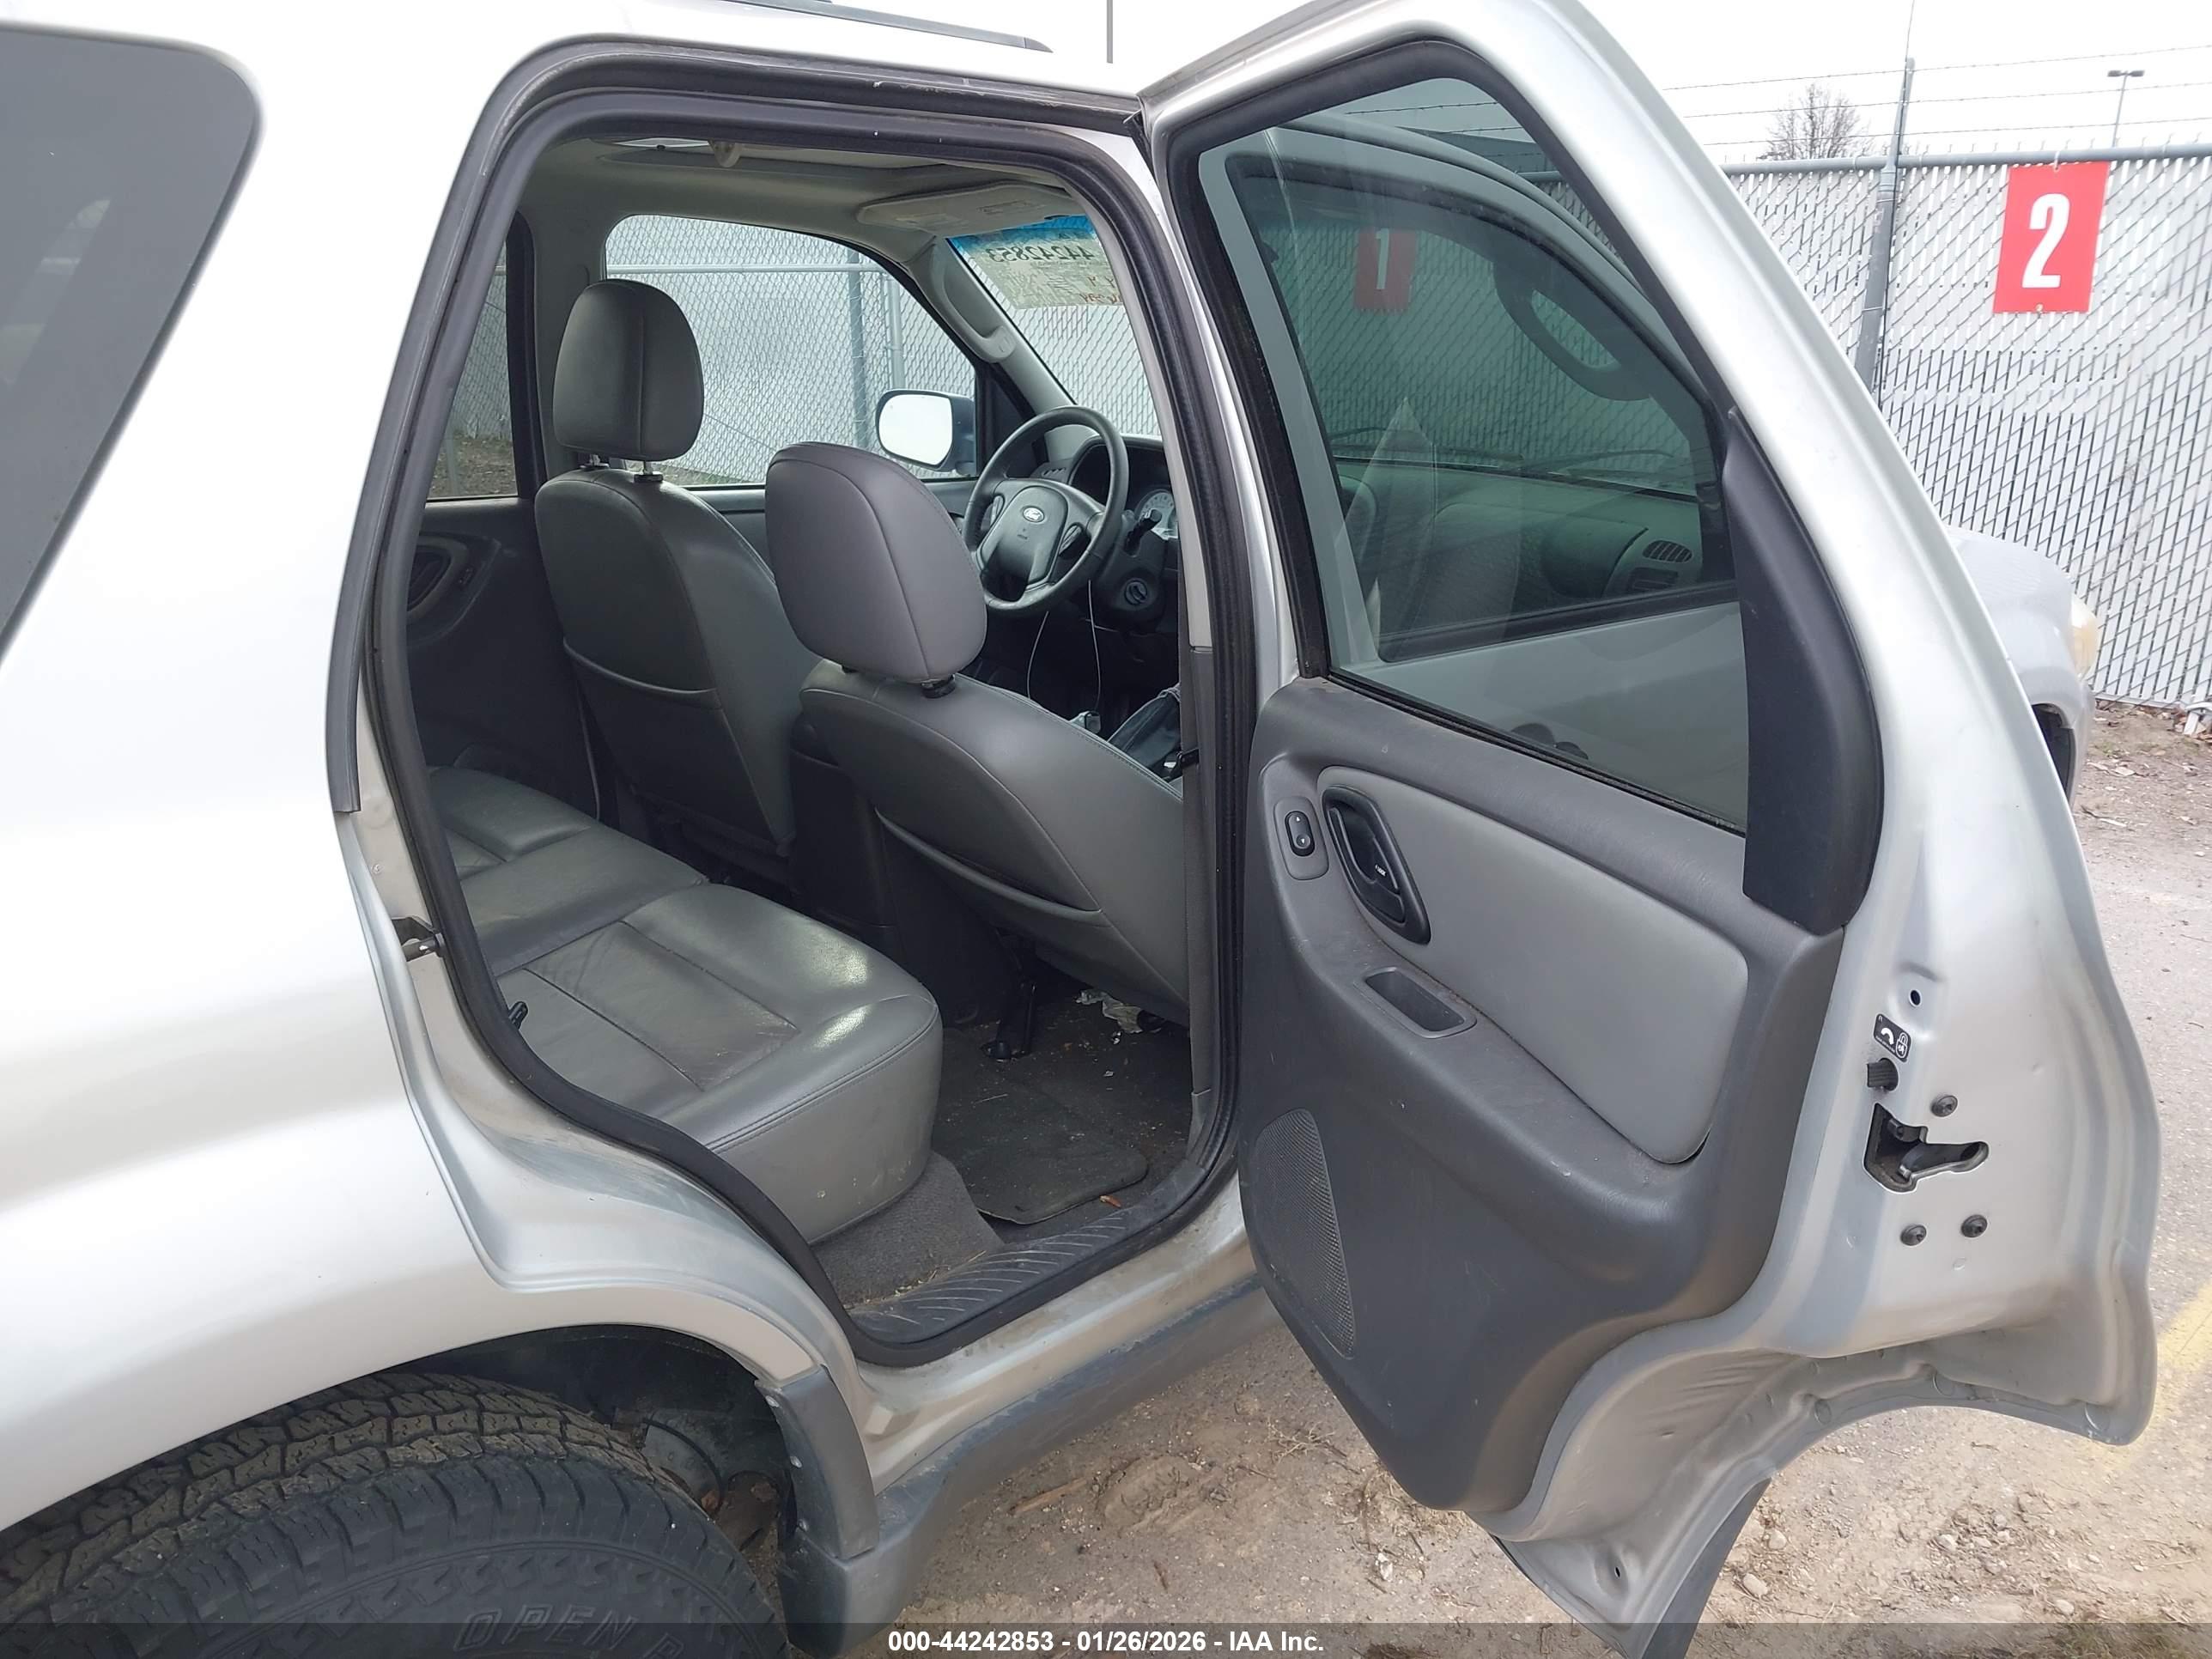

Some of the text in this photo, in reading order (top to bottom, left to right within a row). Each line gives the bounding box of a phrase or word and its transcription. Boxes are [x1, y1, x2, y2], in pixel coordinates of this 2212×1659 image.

[1375, 228, 1390, 290] 1
[2021, 193, 2070, 289] 2
[453, 1603, 639, 1651] OPEN
